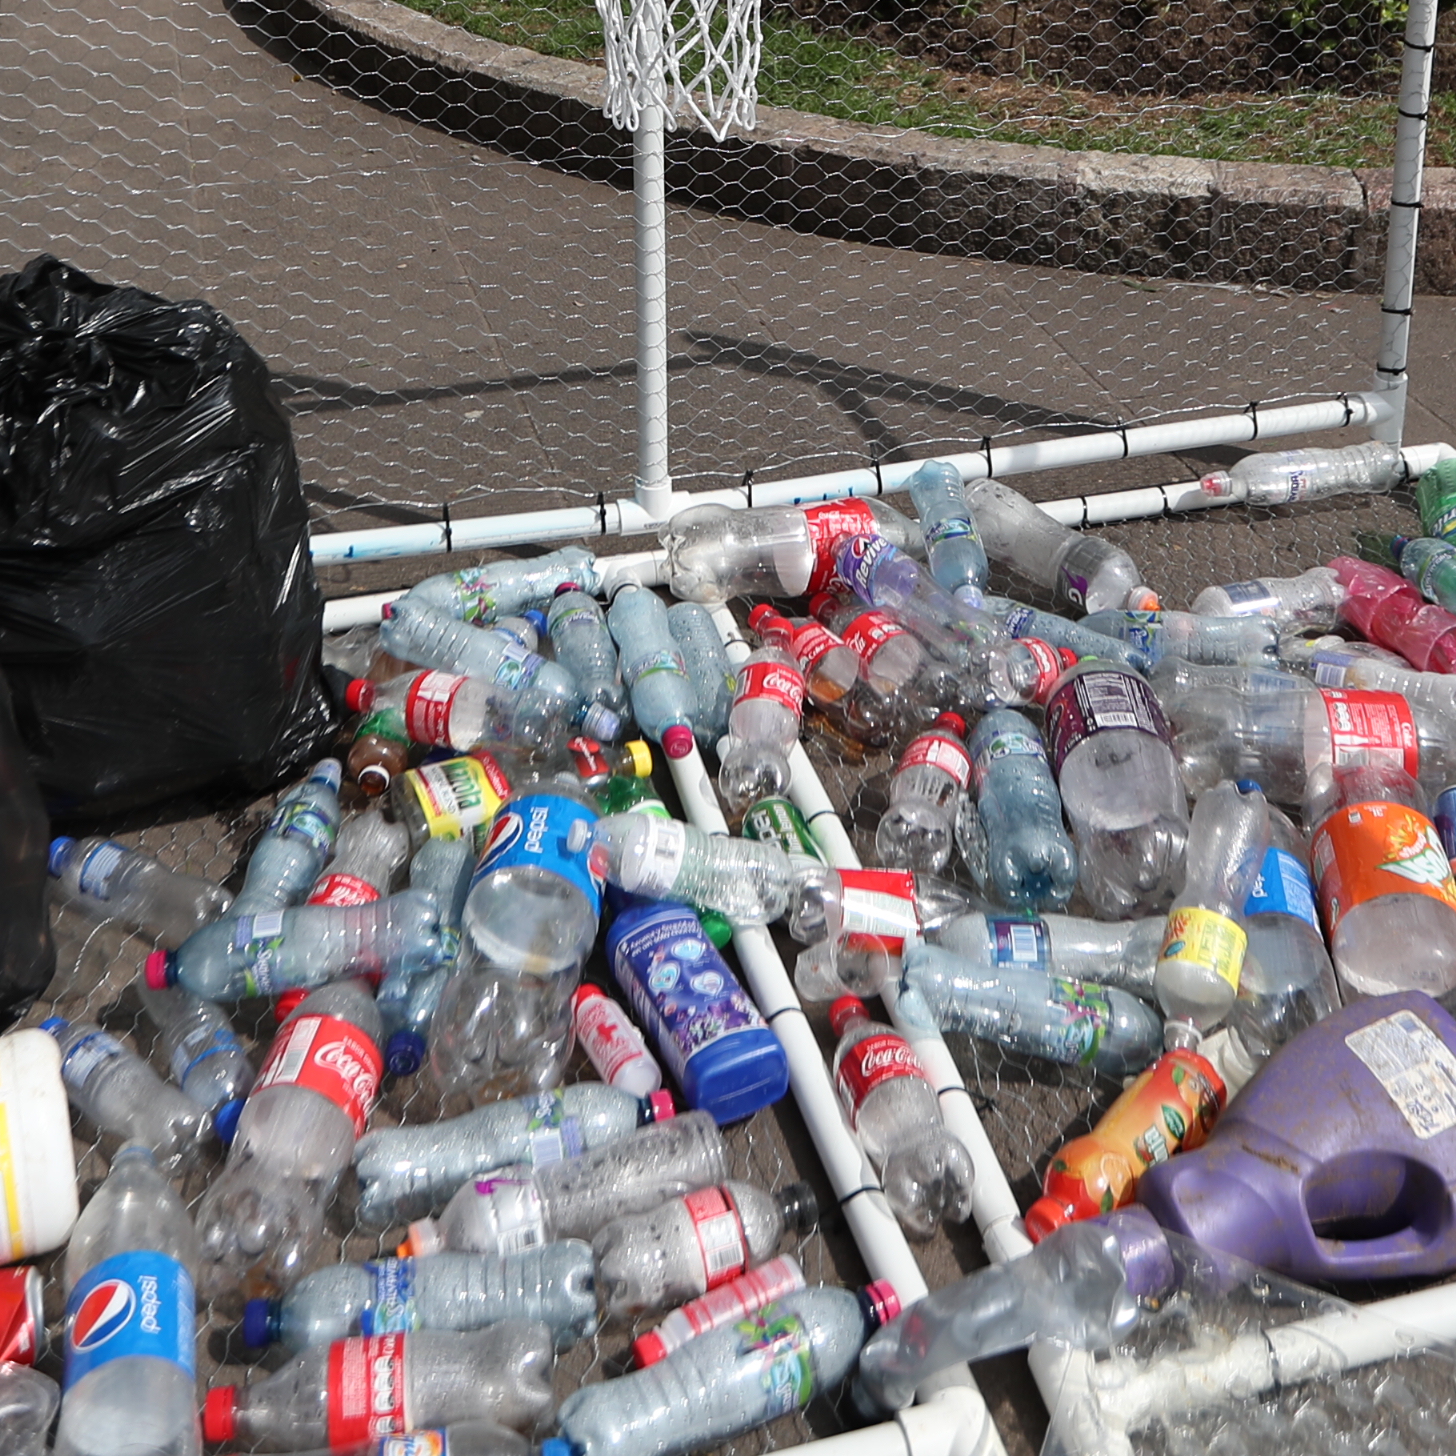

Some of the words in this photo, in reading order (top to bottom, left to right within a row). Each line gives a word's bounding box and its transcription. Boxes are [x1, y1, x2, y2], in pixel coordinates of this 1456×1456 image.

[855, 537, 888, 590] Revive
[524, 806, 549, 853] pepsi
[137, 1275, 162, 1335] pepsi
